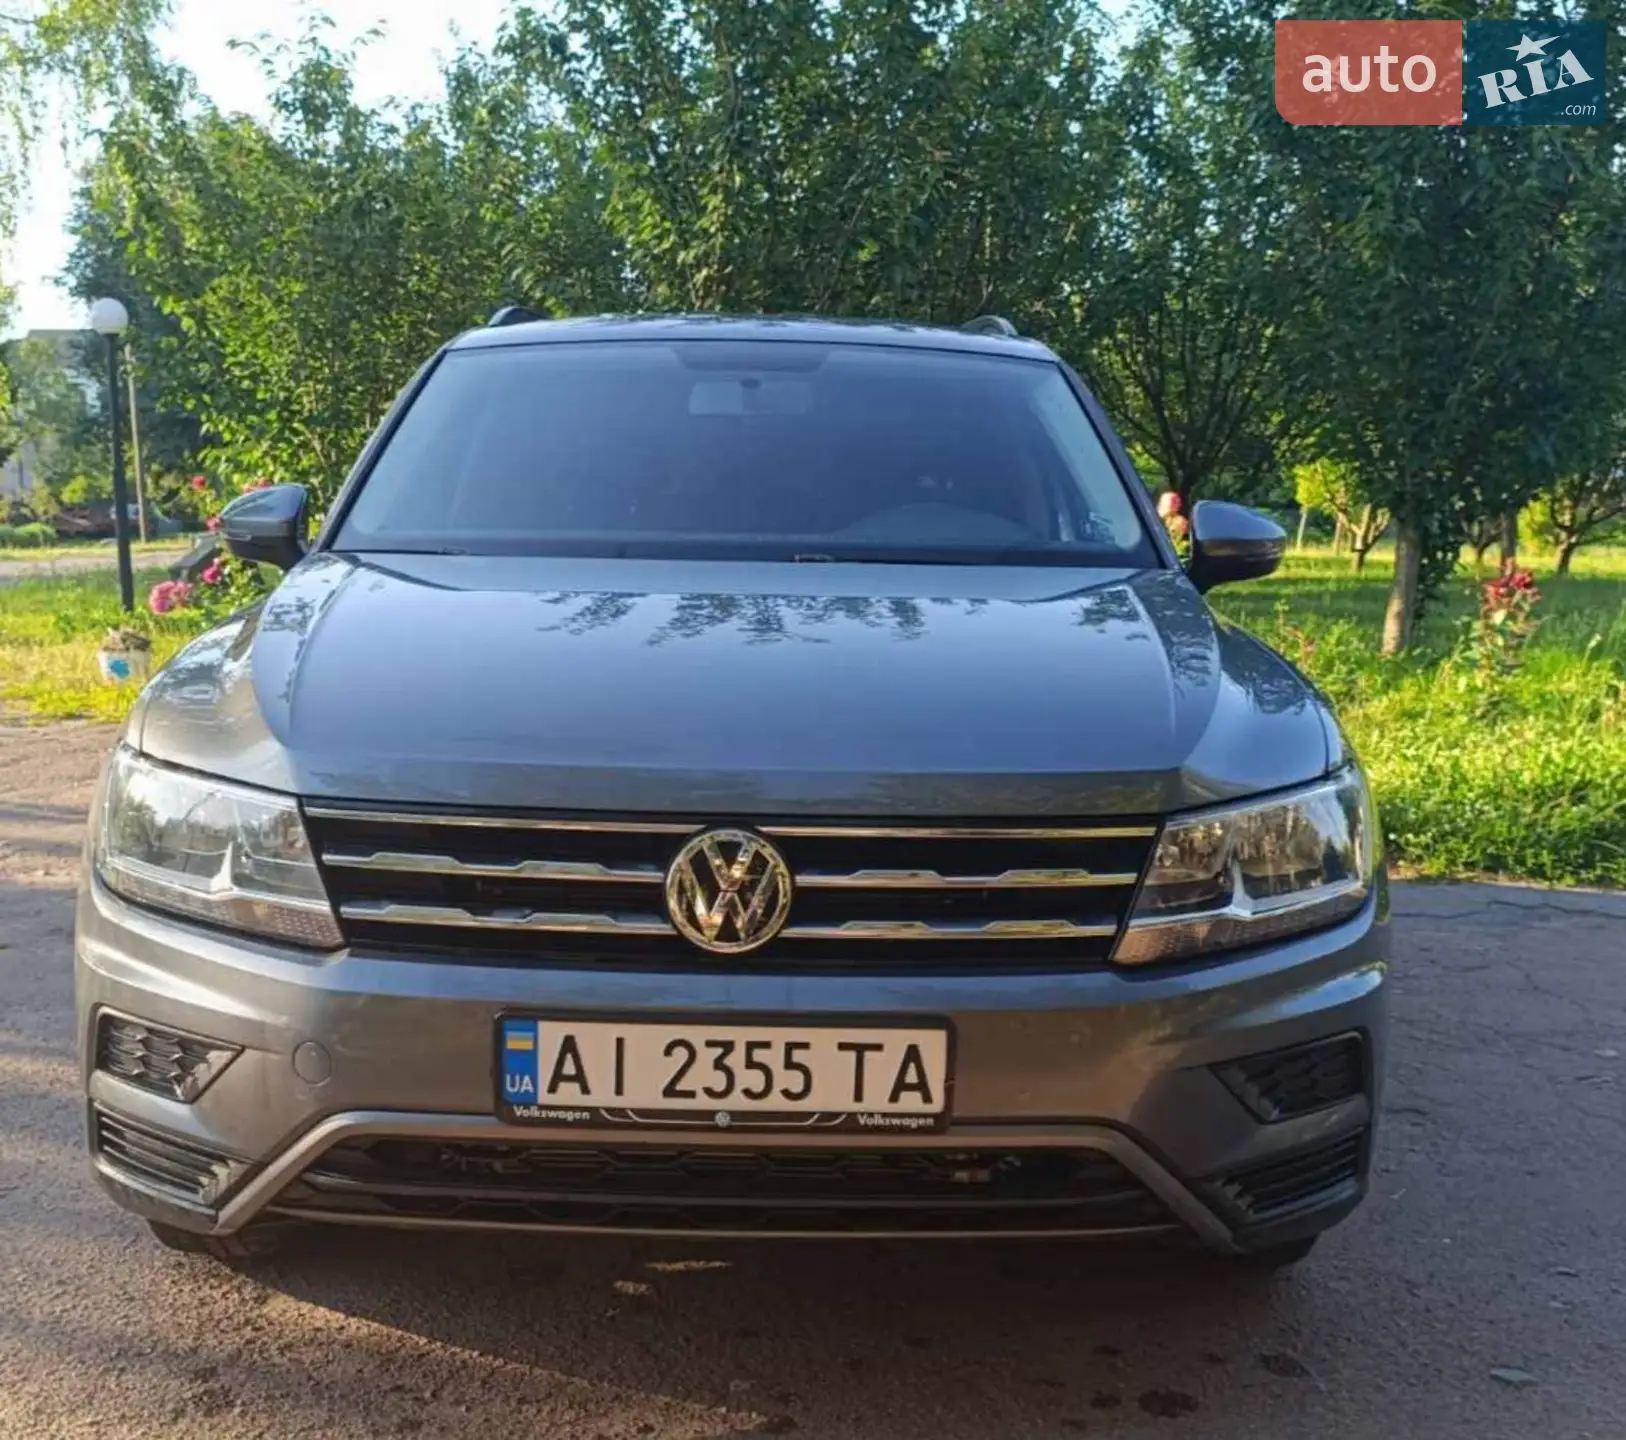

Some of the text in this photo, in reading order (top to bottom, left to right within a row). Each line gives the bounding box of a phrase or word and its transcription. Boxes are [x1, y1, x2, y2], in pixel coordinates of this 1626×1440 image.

[547, 1035, 934, 1104] AI 2355 TA
[506, 1074, 534, 1094] UA
[513, 1105, 590, 1122] Volkswagen
[857, 1112, 935, 1128] Volkswagen
